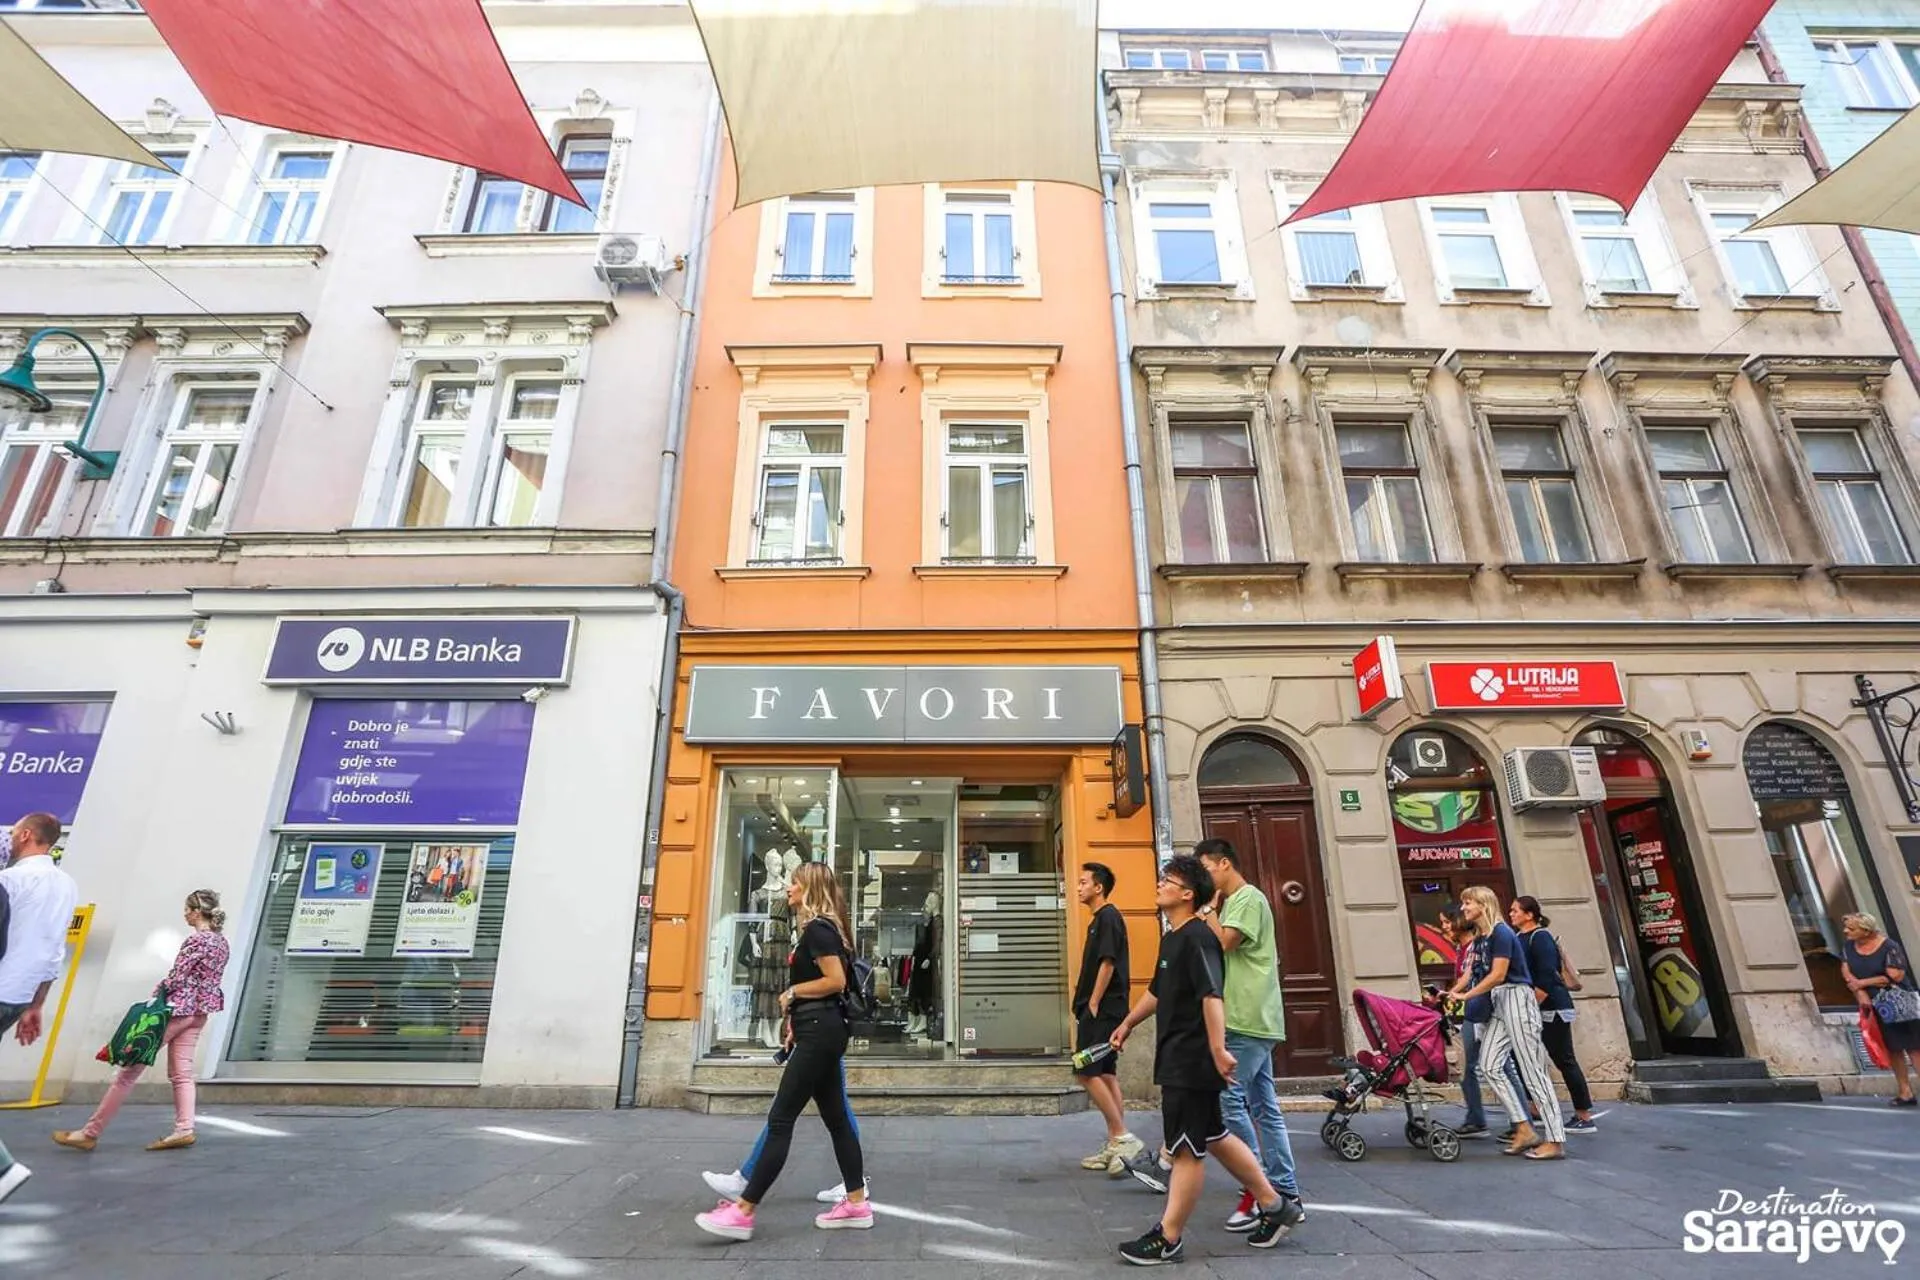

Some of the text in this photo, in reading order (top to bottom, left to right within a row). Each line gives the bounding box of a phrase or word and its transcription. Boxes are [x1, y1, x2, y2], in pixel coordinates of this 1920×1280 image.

[369, 637, 522, 662] NLB Banka
[1507, 667, 1579, 685] LUTRIJA
[747, 686, 1065, 721] FAVORI
[348, 720, 409, 735] Dobro je
[343, 737, 380, 750] znati
[8, 750, 84, 774] Banka
[339, 755, 397, 770] gdje ste
[336, 772, 379, 788] uvijek
[331, 790, 414, 804] dobrodošli.
[1346, 792, 1354, 802] 6
[317, 908, 335, 918] gdje
